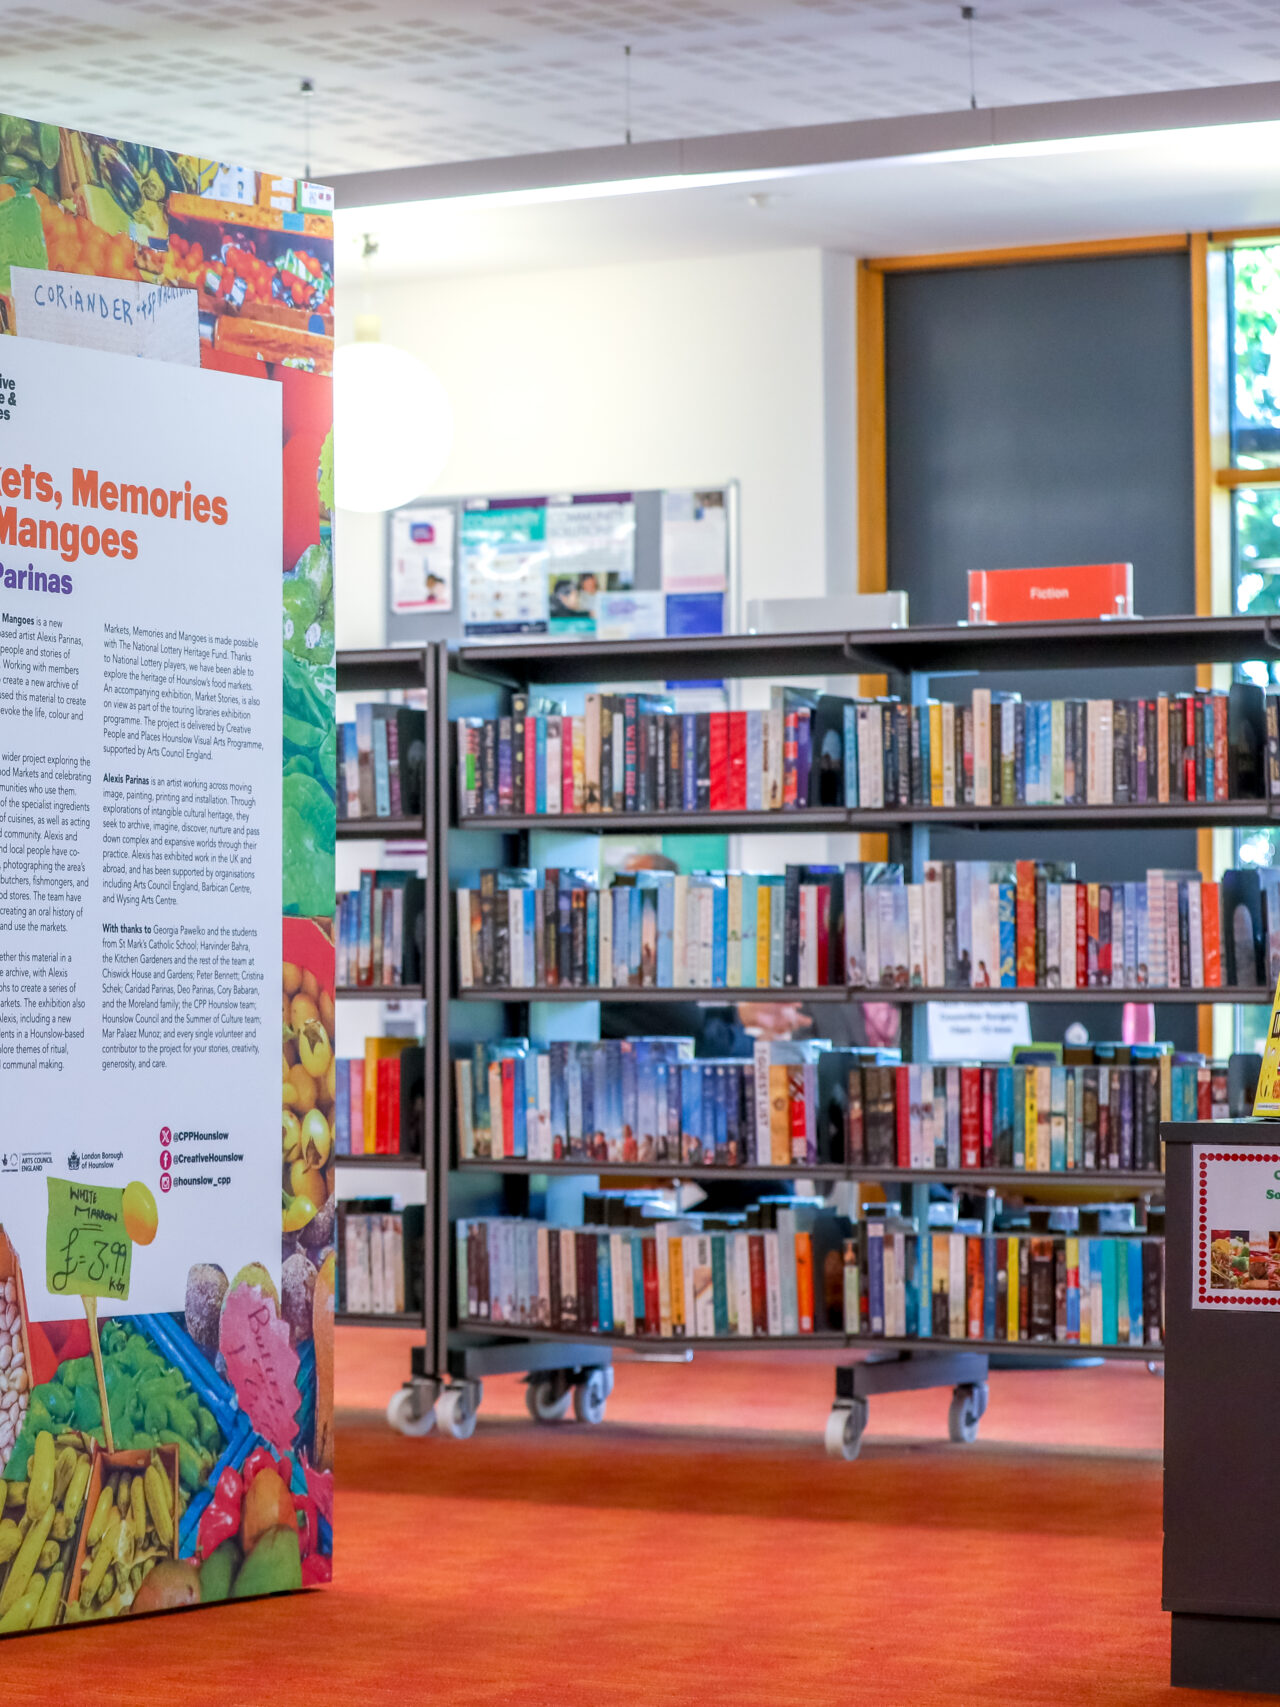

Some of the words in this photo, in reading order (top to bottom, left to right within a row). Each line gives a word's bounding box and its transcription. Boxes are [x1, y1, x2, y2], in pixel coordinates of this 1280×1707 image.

[7, 391, 17, 407] &
[72, 467, 228, 526] Memories
[1030, 587, 1069, 600] Fiction
[2, 612, 35, 626] Mangoes
[43, 619, 47, 627] a
[48, 620, 63, 628] new
[103, 773, 124, 784] Alexis
[125, 774, 150, 785] Parinas
[151, 778, 156, 786] is
[166, 779, 182, 788] artist
[183, 778, 208, 792] working
[209, 782, 229, 791] across
[229, 783, 252, 794] moving
[102, 923, 119, 933] With
[120, 923, 143, 934] thanks
[143, 925, 152, 934] to
[153, 924, 179, 937] Georgia
[207, 927, 219, 936] and
[220, 926, 231, 936] the
[231, 927, 258, 937] students
[101, 1059, 137, 1072] generosity,
[138, 1059, 151, 1068] and
[151, 1060, 167, 1068] care.
[33, 1156, 53, 1164] COUNCIL
[81, 1152, 101, 1160] London
[101, 1151, 124, 1161] Borough
[21, 1164, 43, 1172] ENGLAND
[81, 1161, 88, 1170] of
[88, 1161, 114, 1169] Hounslow
[69, 1186, 97, 1205] WHITE
